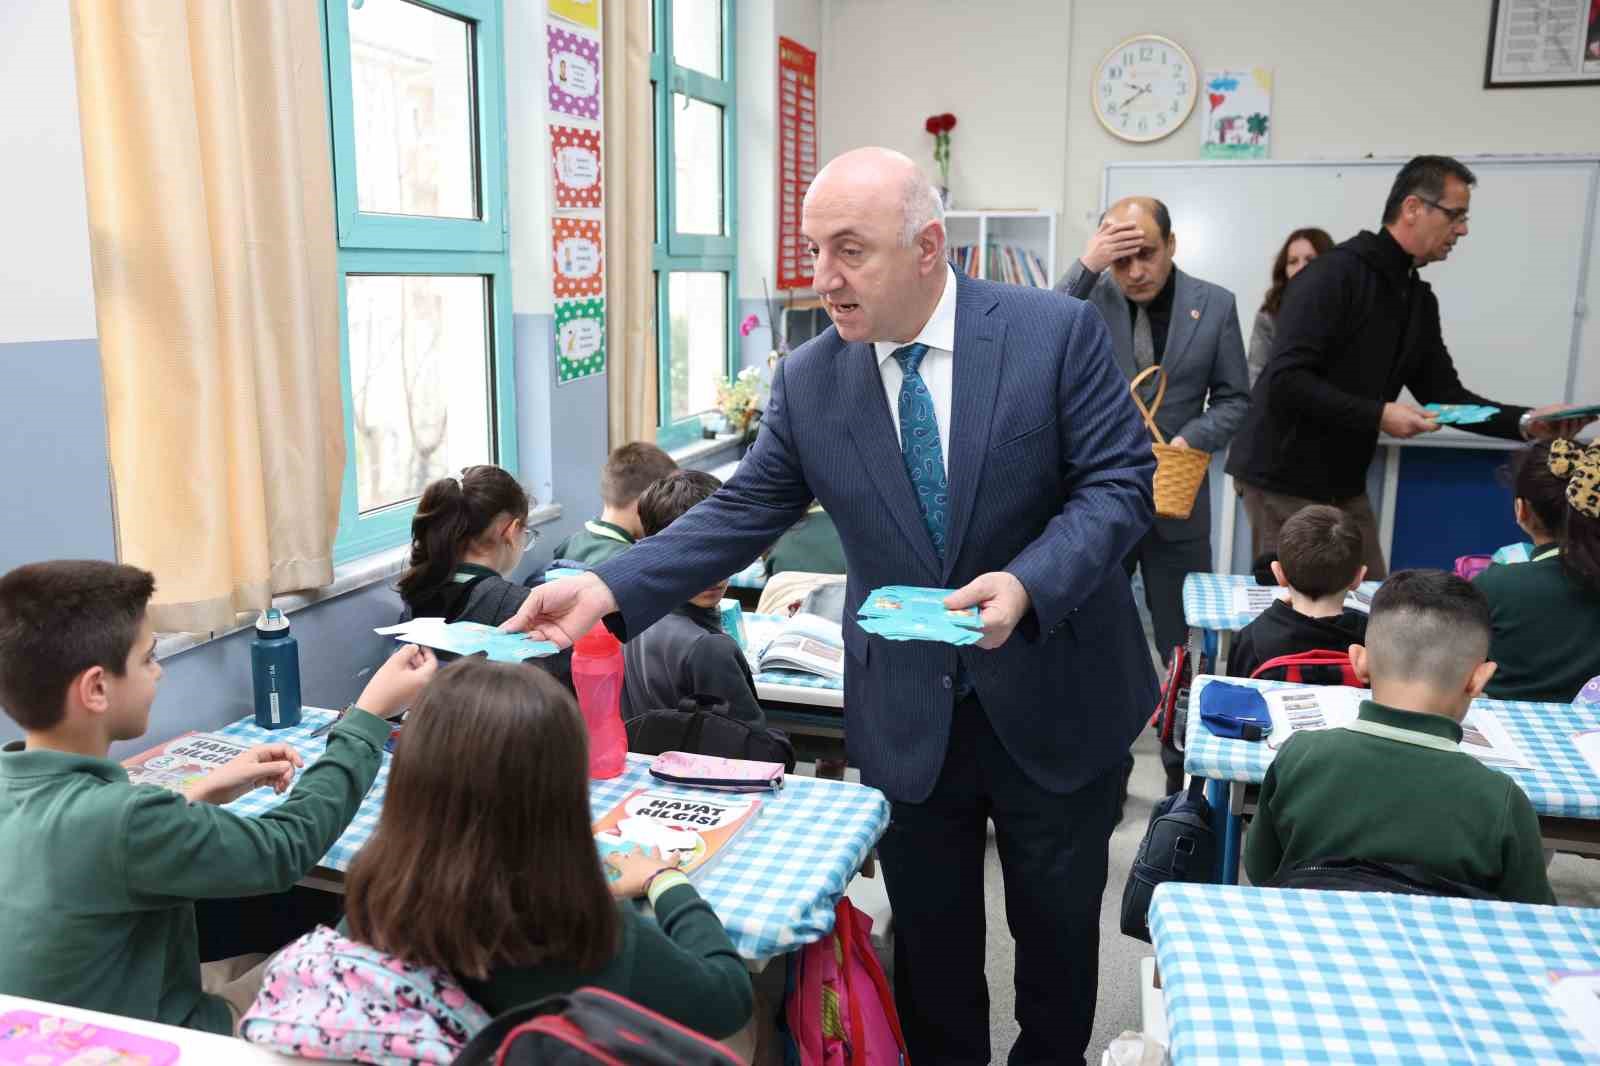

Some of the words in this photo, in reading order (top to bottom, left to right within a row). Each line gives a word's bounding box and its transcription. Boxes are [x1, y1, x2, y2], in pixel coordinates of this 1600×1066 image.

[1122, 51, 1134, 65] 11
[1139, 47, 1153, 62] 12
[1108, 66, 1122, 79] 10
[1172, 64, 1183, 78] 2
[1103, 82, 1112, 96] 9
[1176, 81, 1186, 96] 3
[1107, 101, 1117, 112] 8
[1169, 99, 1179, 112] 4
[1120, 113, 1129, 127] 7
[1138, 114, 1147, 130] 6
[1156, 112, 1167, 127] 5
[191, 740, 242, 756] HAYA
[649, 800, 726, 816] HAYAT
